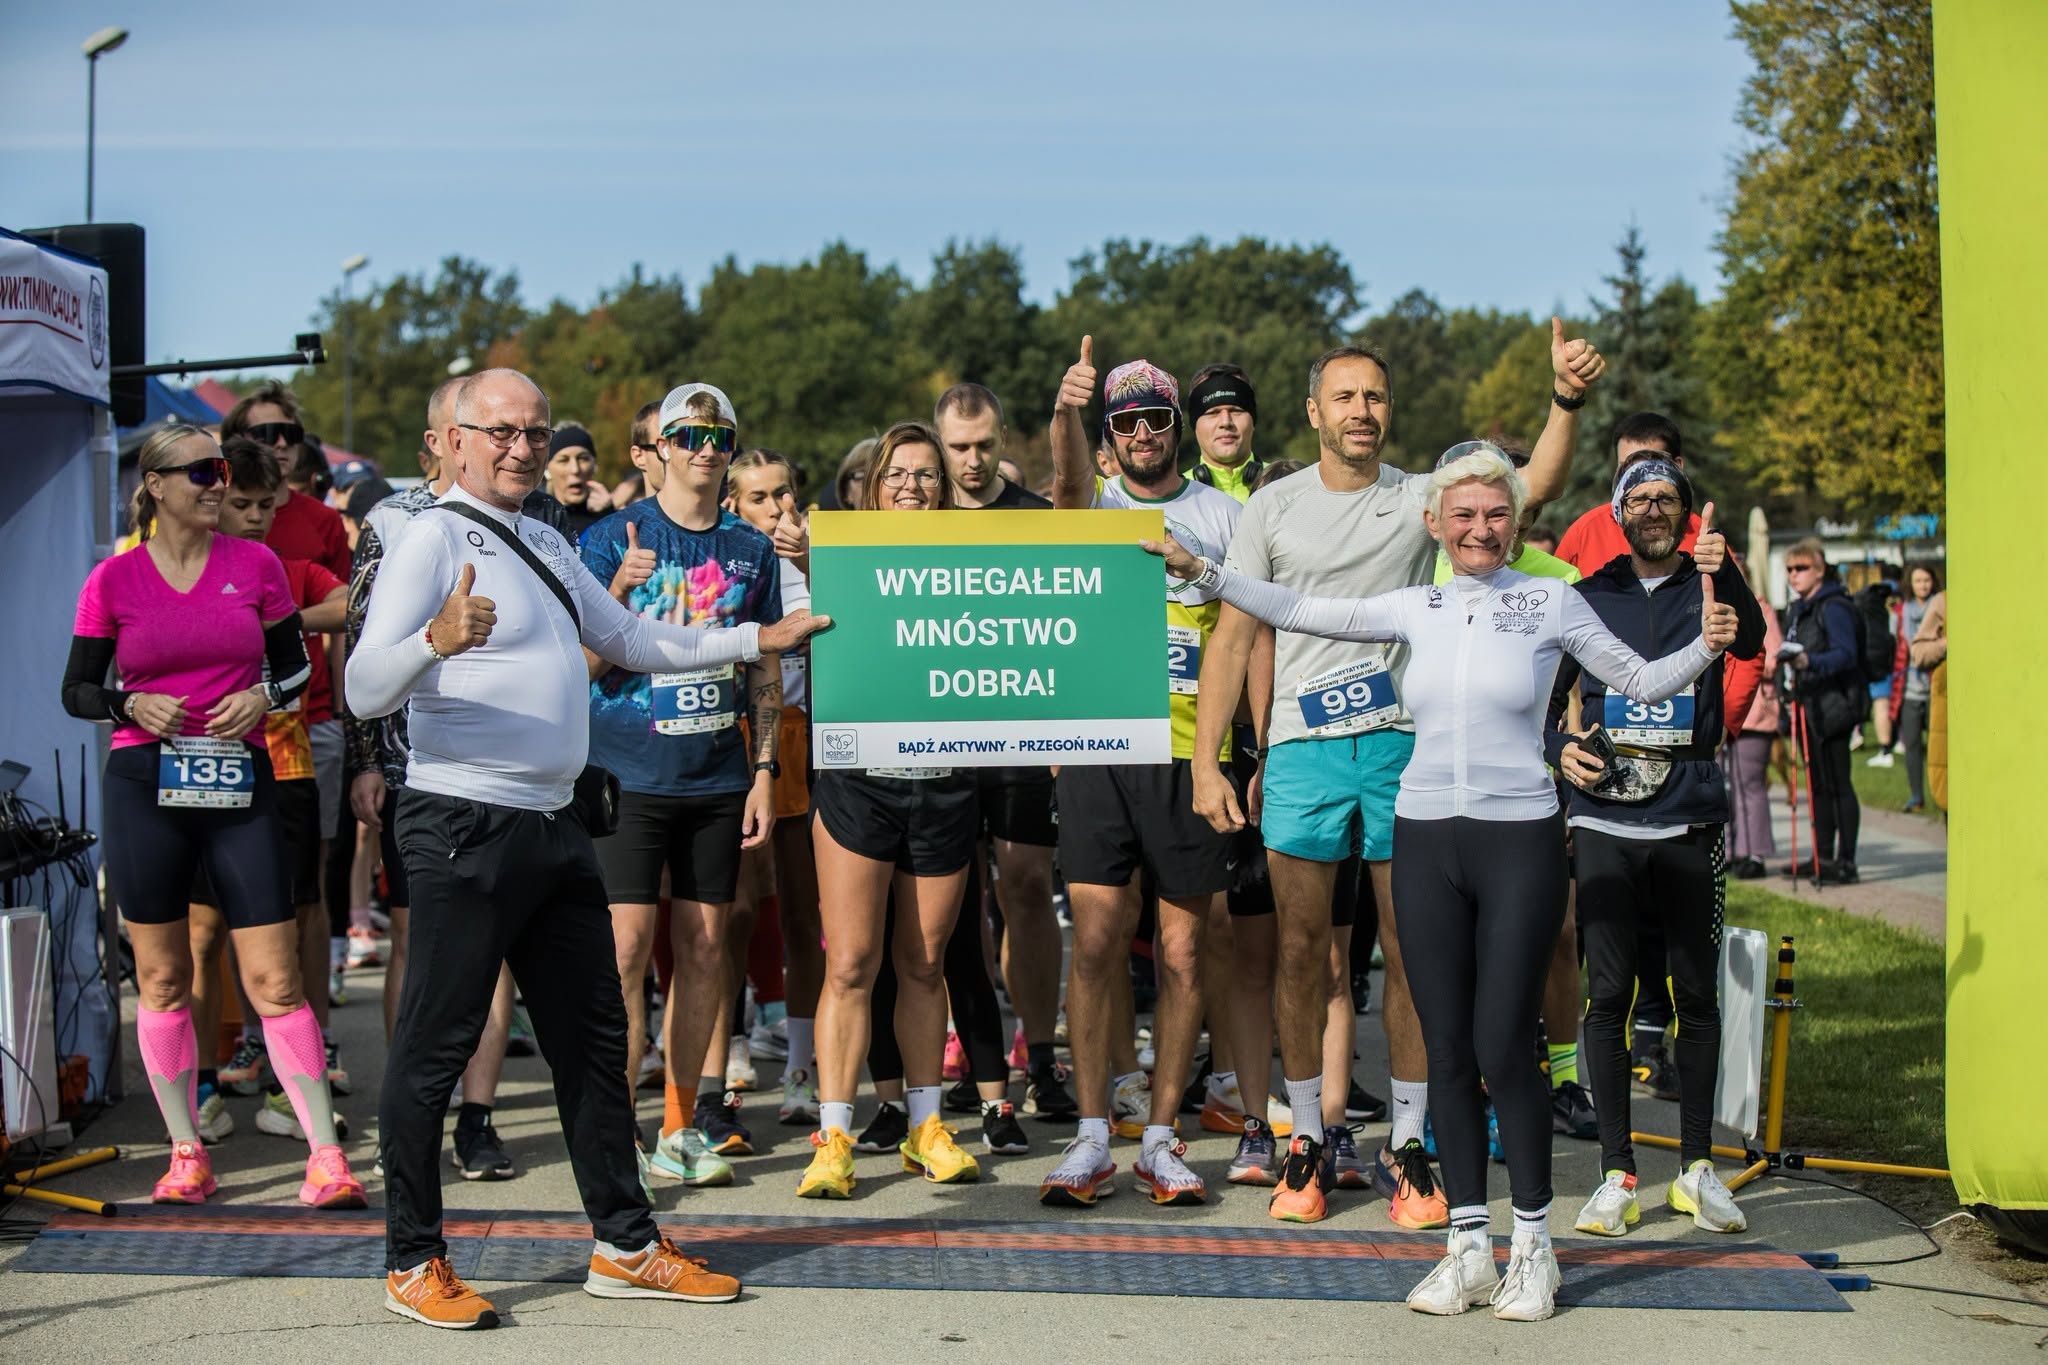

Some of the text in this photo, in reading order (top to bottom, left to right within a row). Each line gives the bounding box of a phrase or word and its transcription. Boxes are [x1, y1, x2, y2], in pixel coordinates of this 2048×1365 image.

[875, 567, 1102, 596] WYBIEGAŁEM
[896, 611, 1077, 647] MNÓSTWO
[1492, 611, 1545, 619] HOSPICJUM
[676, 683, 720, 712] 89
[929, 668, 1056, 698] DOBRA!
[1321, 682, 1372, 715] 99
[1625, 698, 1674, 723] 39
[898, 738, 936, 757] BĄDŹ
[937, 740, 1007, 753] AKTYWNY
[1018, 735, 1085, 752] PRZEGOŃ
[1087, 738, 1130, 751] RAKA!
[174, 757, 243, 785] 135
